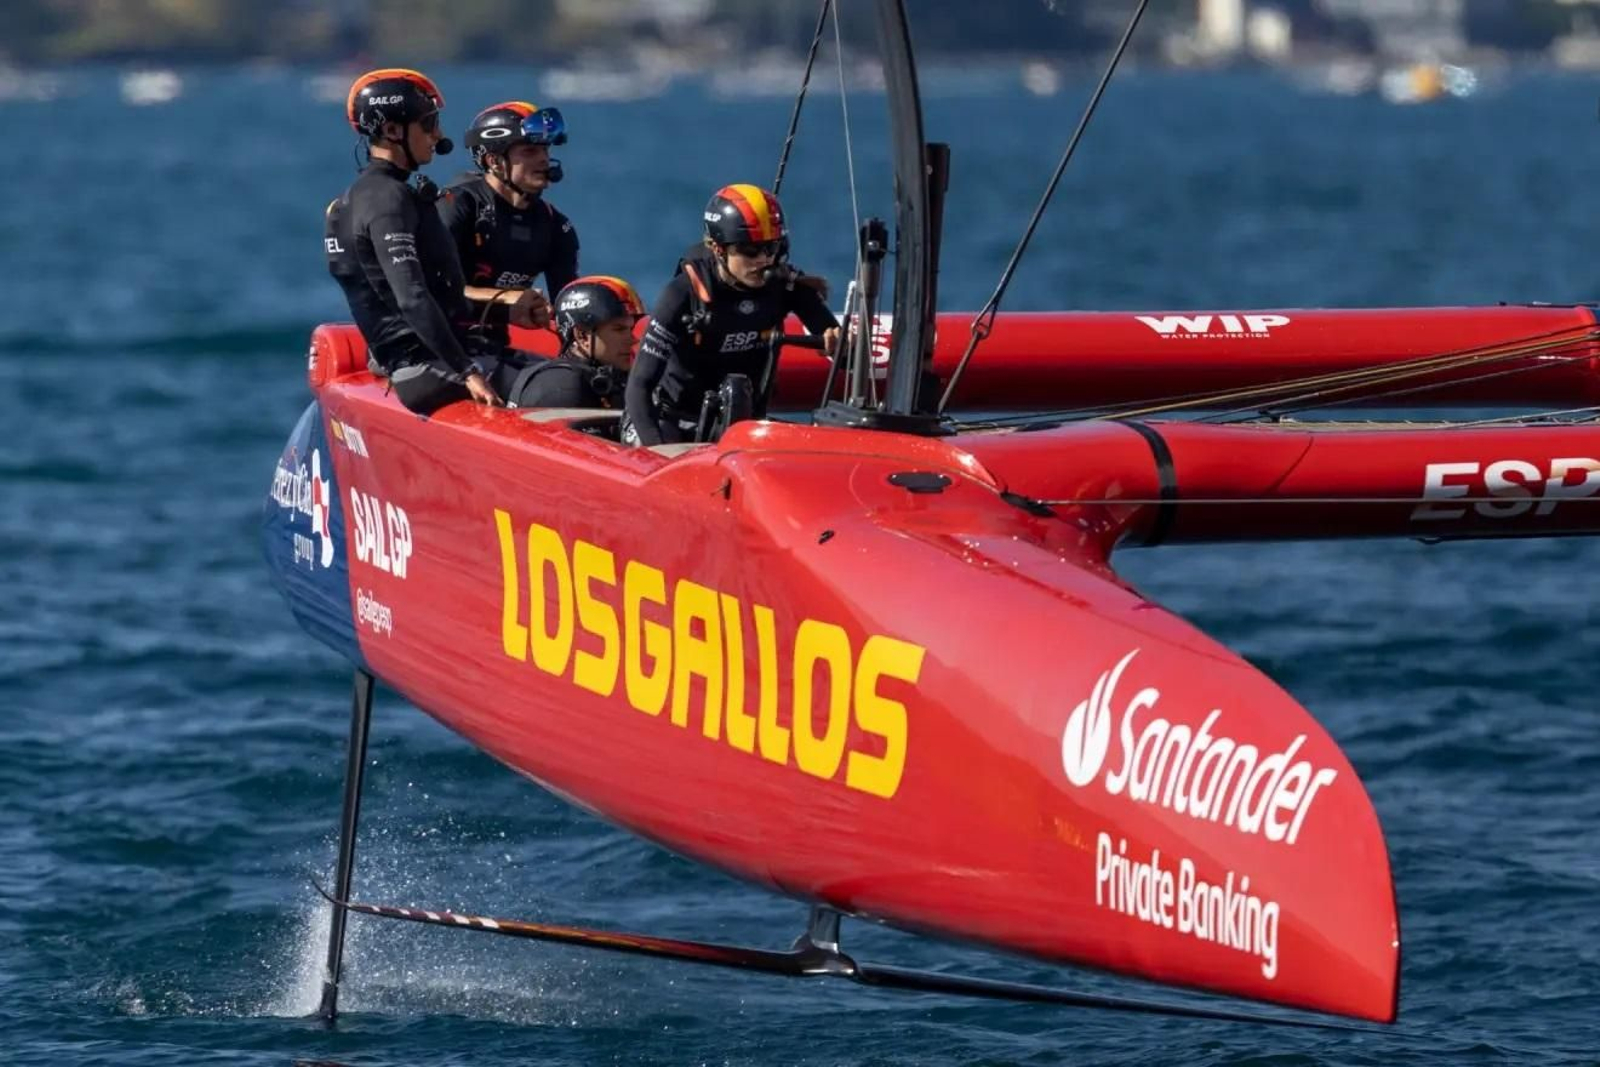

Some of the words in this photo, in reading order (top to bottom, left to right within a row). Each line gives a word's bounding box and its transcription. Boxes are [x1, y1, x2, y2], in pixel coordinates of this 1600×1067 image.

[1134, 314, 1291, 333] WIP
[1410, 457, 1600, 521] ESP
[1105, 687, 1338, 845] Santander
[1095, 831, 1174, 929] Private
[1178, 857, 1280, 980] Banking
